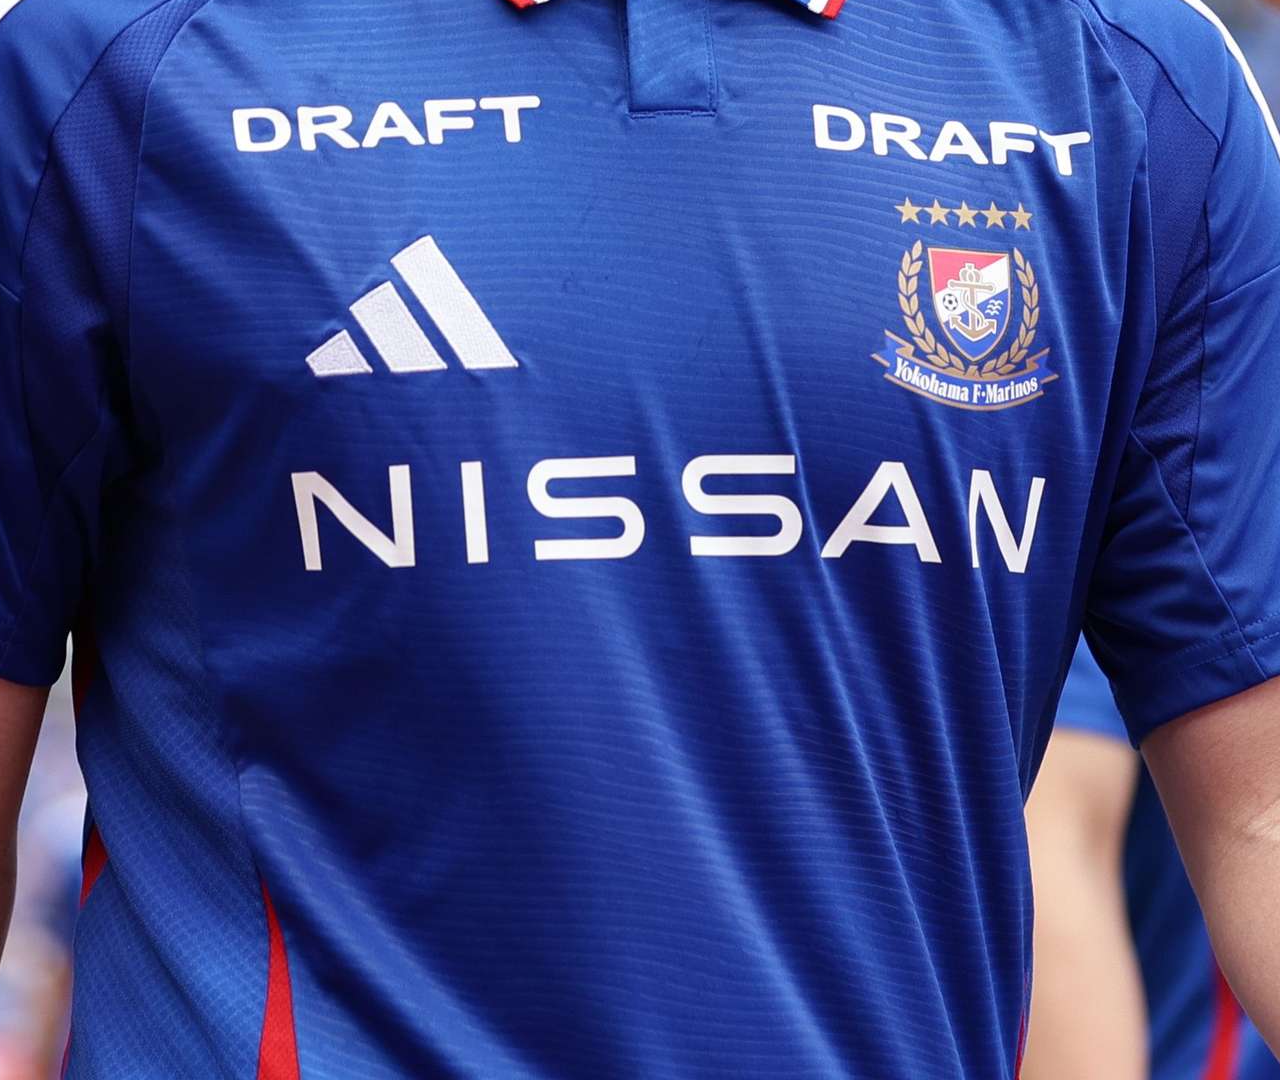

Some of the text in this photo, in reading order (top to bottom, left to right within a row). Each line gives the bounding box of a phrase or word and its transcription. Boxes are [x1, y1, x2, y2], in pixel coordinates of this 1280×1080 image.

[232, 95, 541, 152] DRAFT
[812, 104, 1091, 176] DRAFT
[894, 356, 969, 402] Yokohama
[291, 454, 1046, 574] NISSAN
